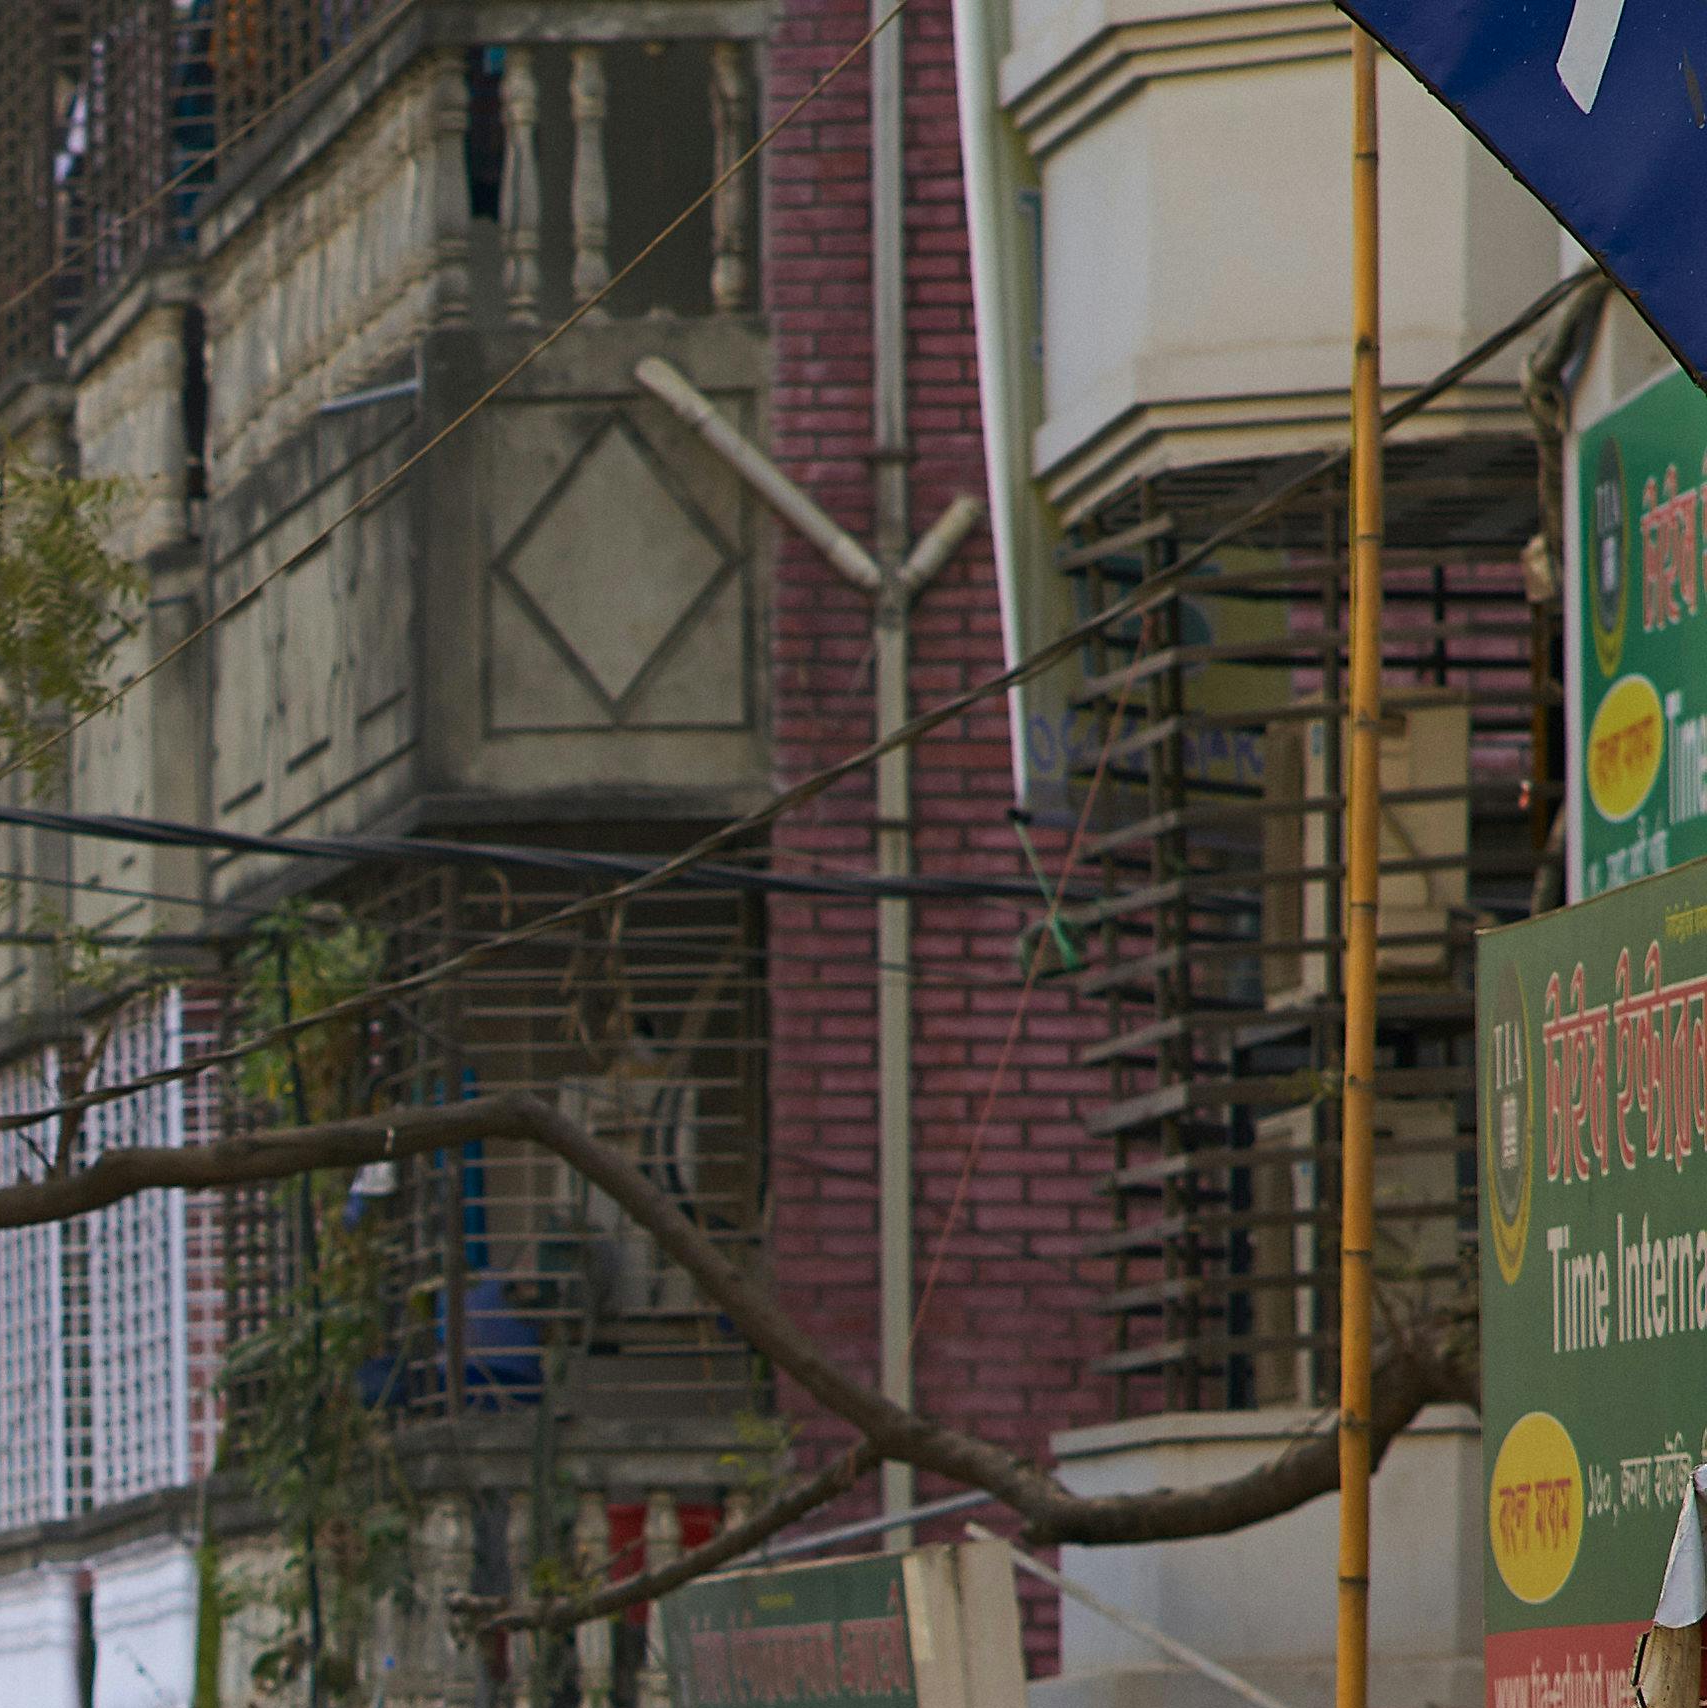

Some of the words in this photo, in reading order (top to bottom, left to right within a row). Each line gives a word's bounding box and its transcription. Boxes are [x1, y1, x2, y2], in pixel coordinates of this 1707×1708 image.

[1494, 1020, 1523, 1091] TIA
[1543, 960, 1609, 1185] টাইম
[1547, 1223, 1609, 1354] Time
[1654, 1431, 1692, 1510] হাউজি
